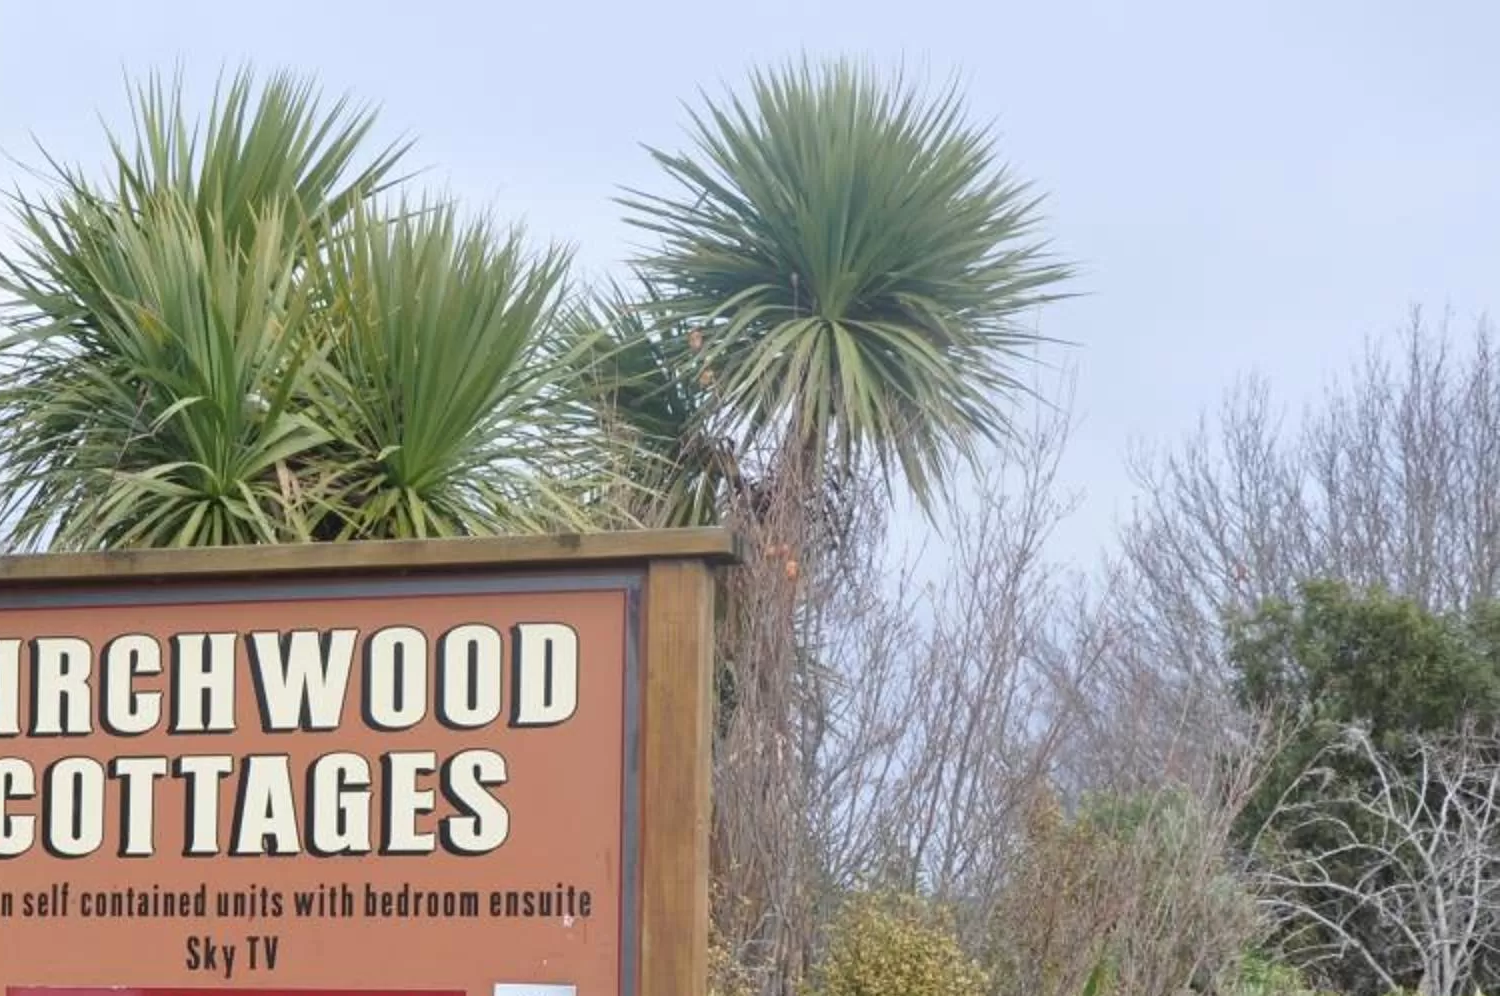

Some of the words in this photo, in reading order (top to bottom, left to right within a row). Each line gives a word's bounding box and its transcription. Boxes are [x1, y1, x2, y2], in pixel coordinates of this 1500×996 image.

[22, 882, 70, 917] self
[80, 882, 207, 917] contained
[216, 882, 284, 918] units
[293, 882, 354, 917] with
[364, 882, 480, 917] bedroom
[488, 881, 592, 917] ensuite
[185, 935, 237, 979] Sky
[245, 935, 279, 970] TV
